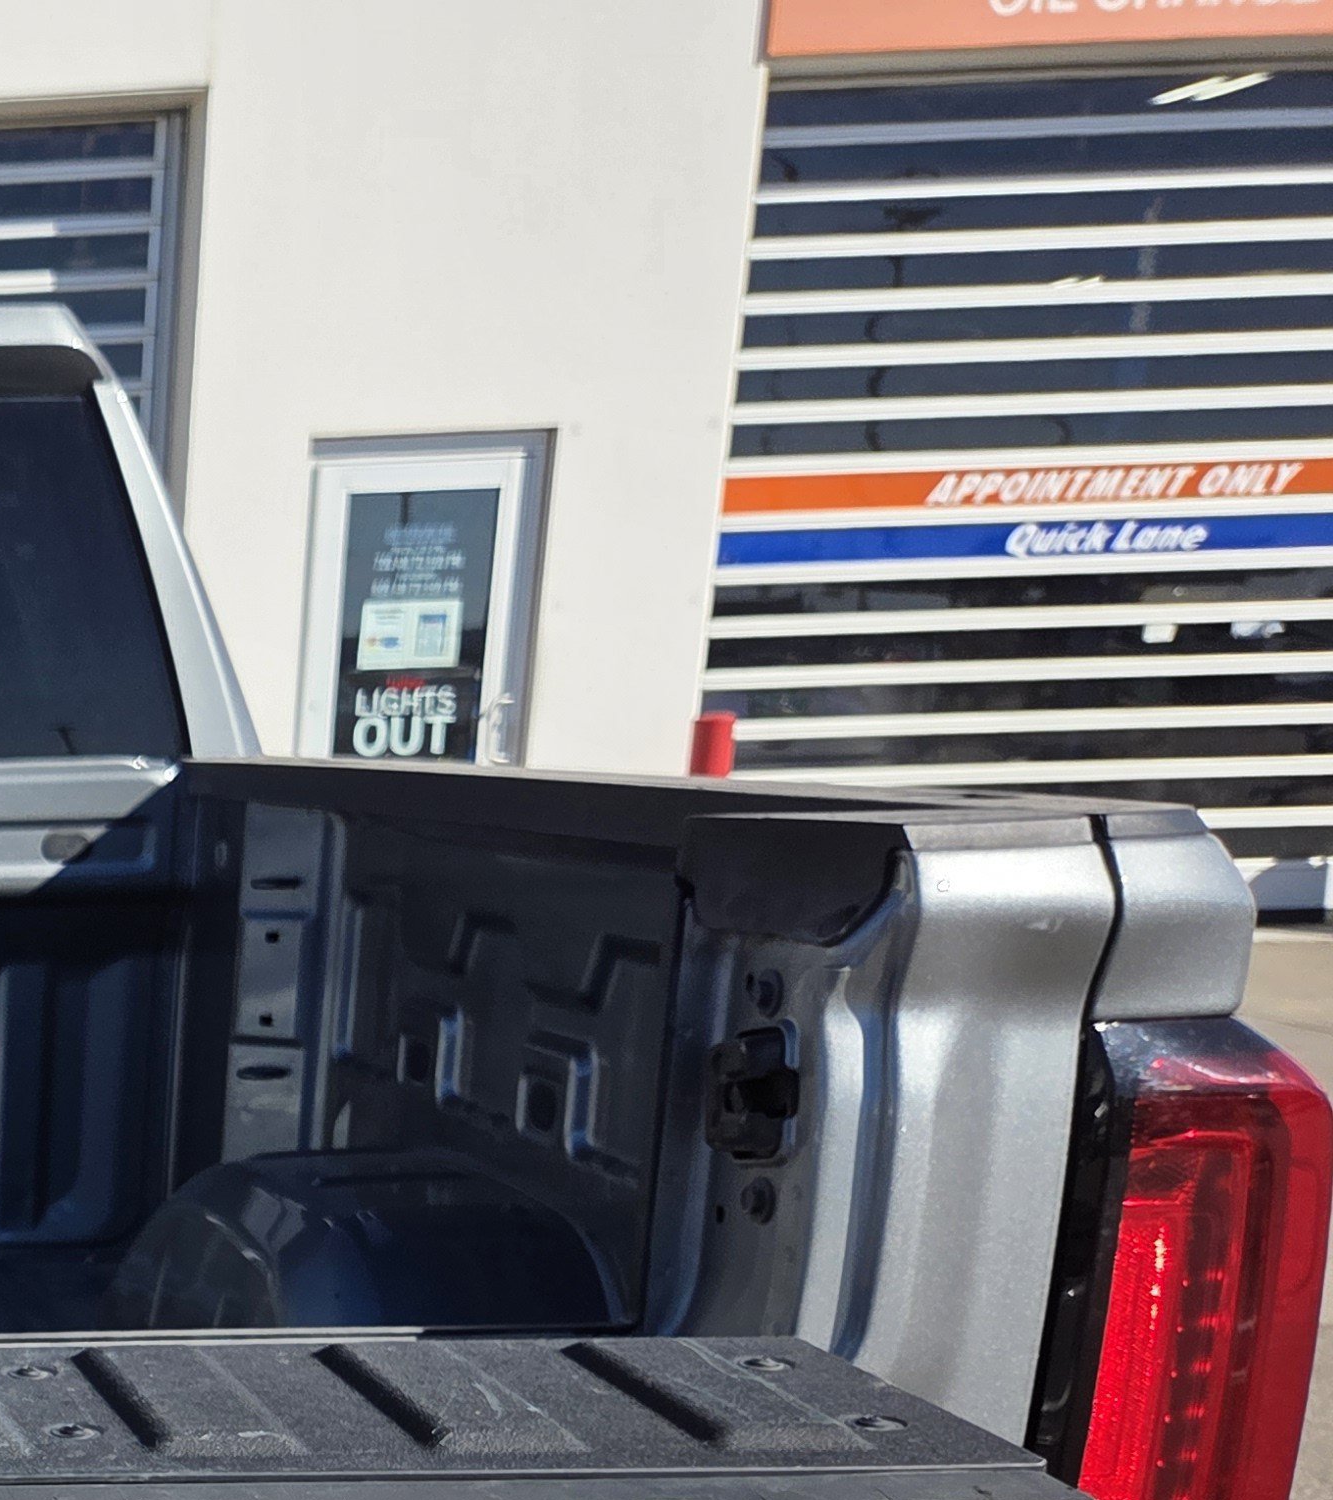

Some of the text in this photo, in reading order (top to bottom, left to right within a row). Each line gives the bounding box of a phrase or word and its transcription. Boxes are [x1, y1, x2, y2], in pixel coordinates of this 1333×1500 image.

[924, 462, 1304, 506] APPOINTMENT ONLY
[1005, 520, 1208, 558] Quick Lane
[354, 684, 456, 717] LIGHTS
[353, 715, 456, 757] OUT
